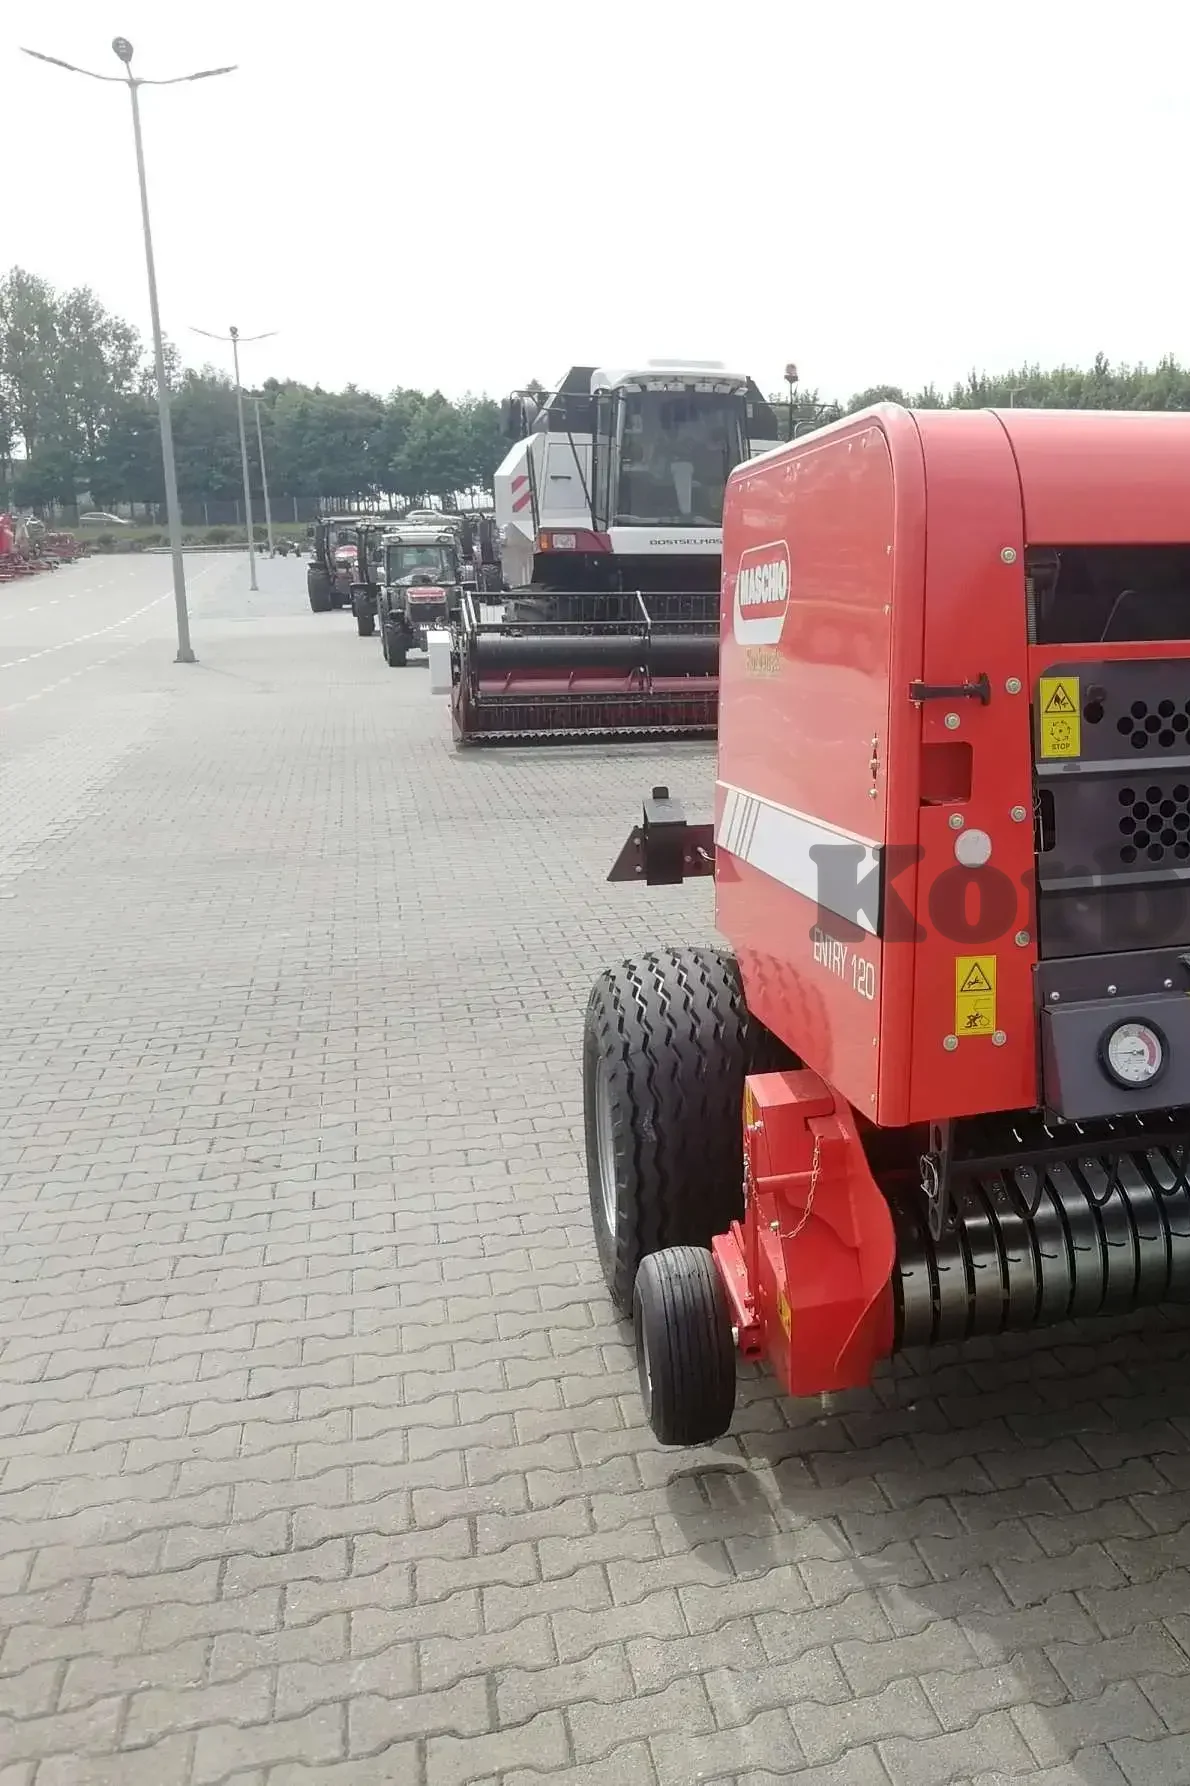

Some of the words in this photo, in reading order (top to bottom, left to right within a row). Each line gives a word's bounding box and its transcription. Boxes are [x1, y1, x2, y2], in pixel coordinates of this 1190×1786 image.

[740, 559, 788, 606] MASCHIO
[1052, 742, 1071, 751] STOP
[813, 927, 848, 980] ENTRY
[851, 953, 875, 1001] 120
